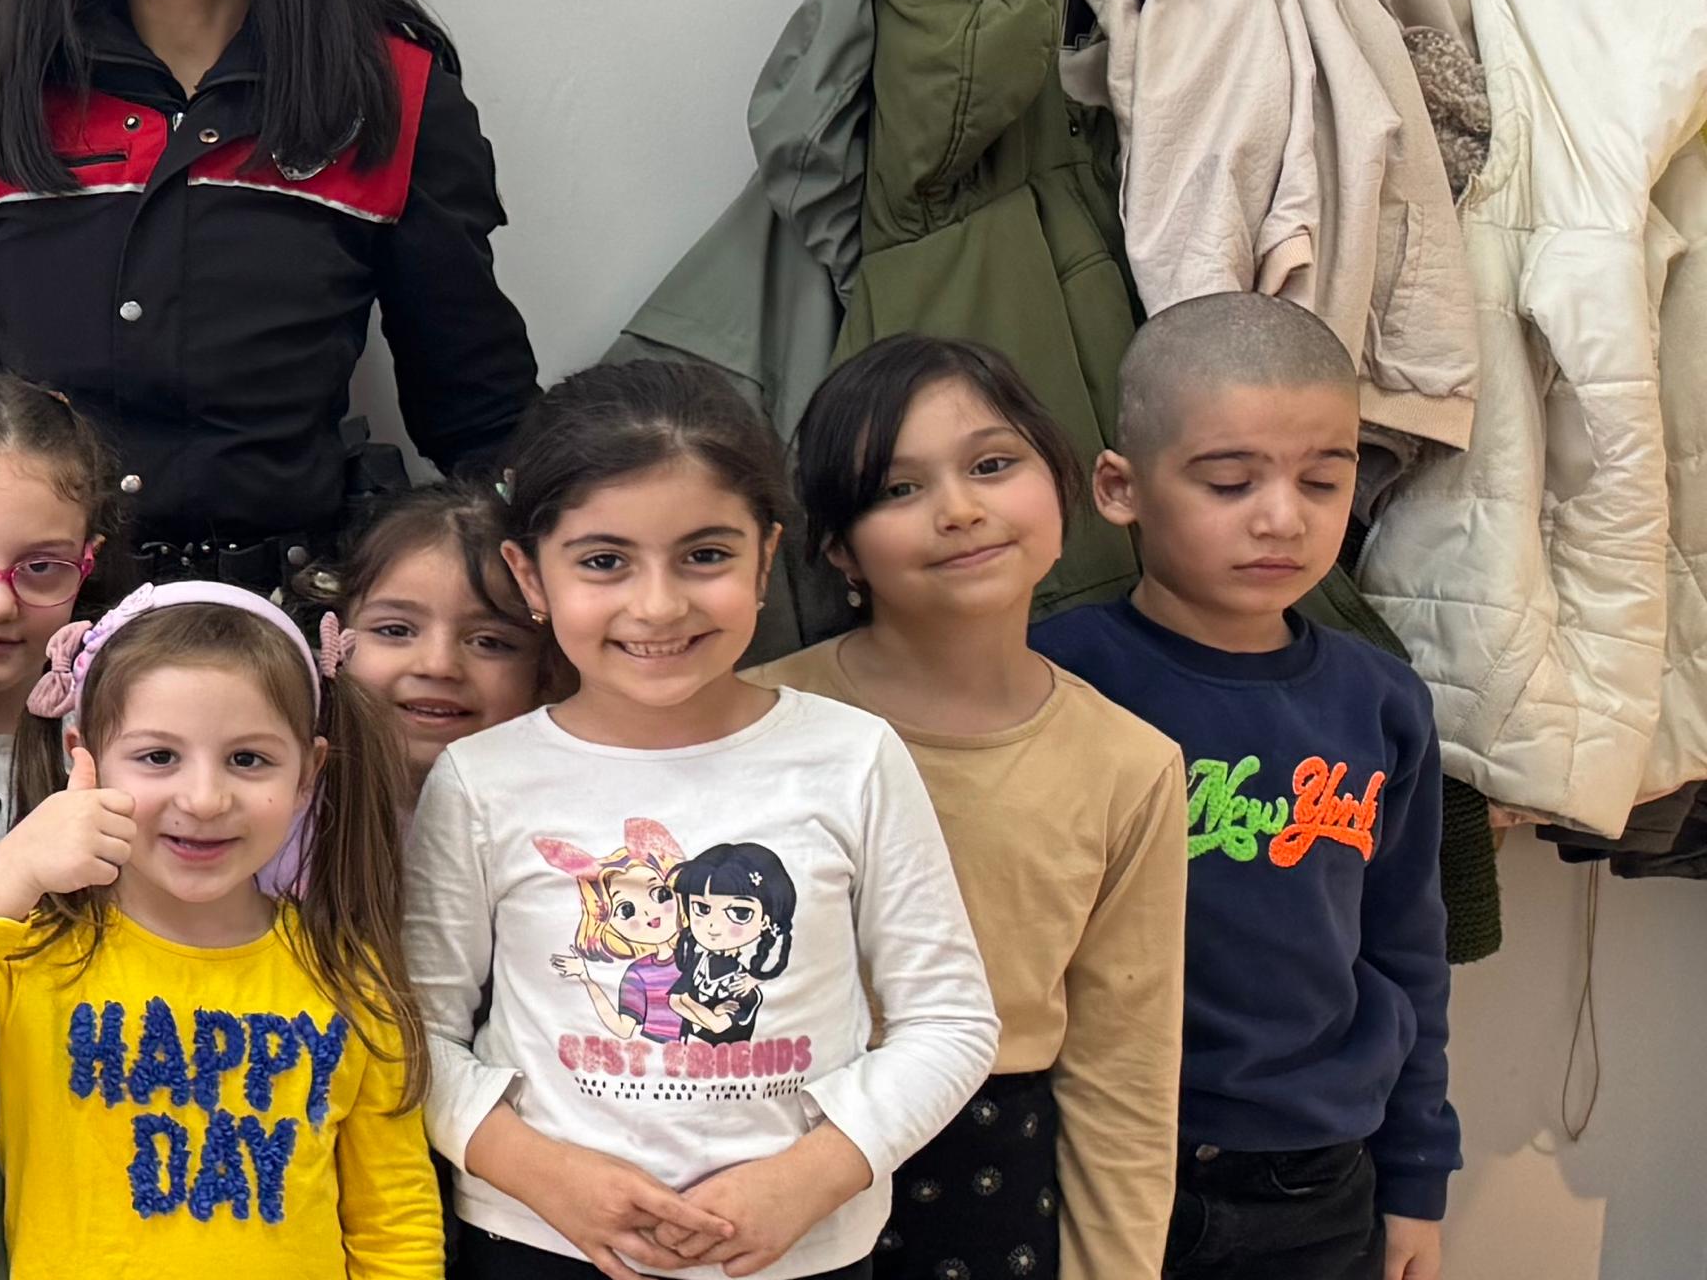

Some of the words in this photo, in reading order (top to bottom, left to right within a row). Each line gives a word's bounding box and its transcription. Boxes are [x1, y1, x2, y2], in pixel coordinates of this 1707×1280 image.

[67, 995, 350, 1133] HAPPY
[661, 1034, 813, 1080] FRIENDS
[126, 1107, 301, 1225] DAY
